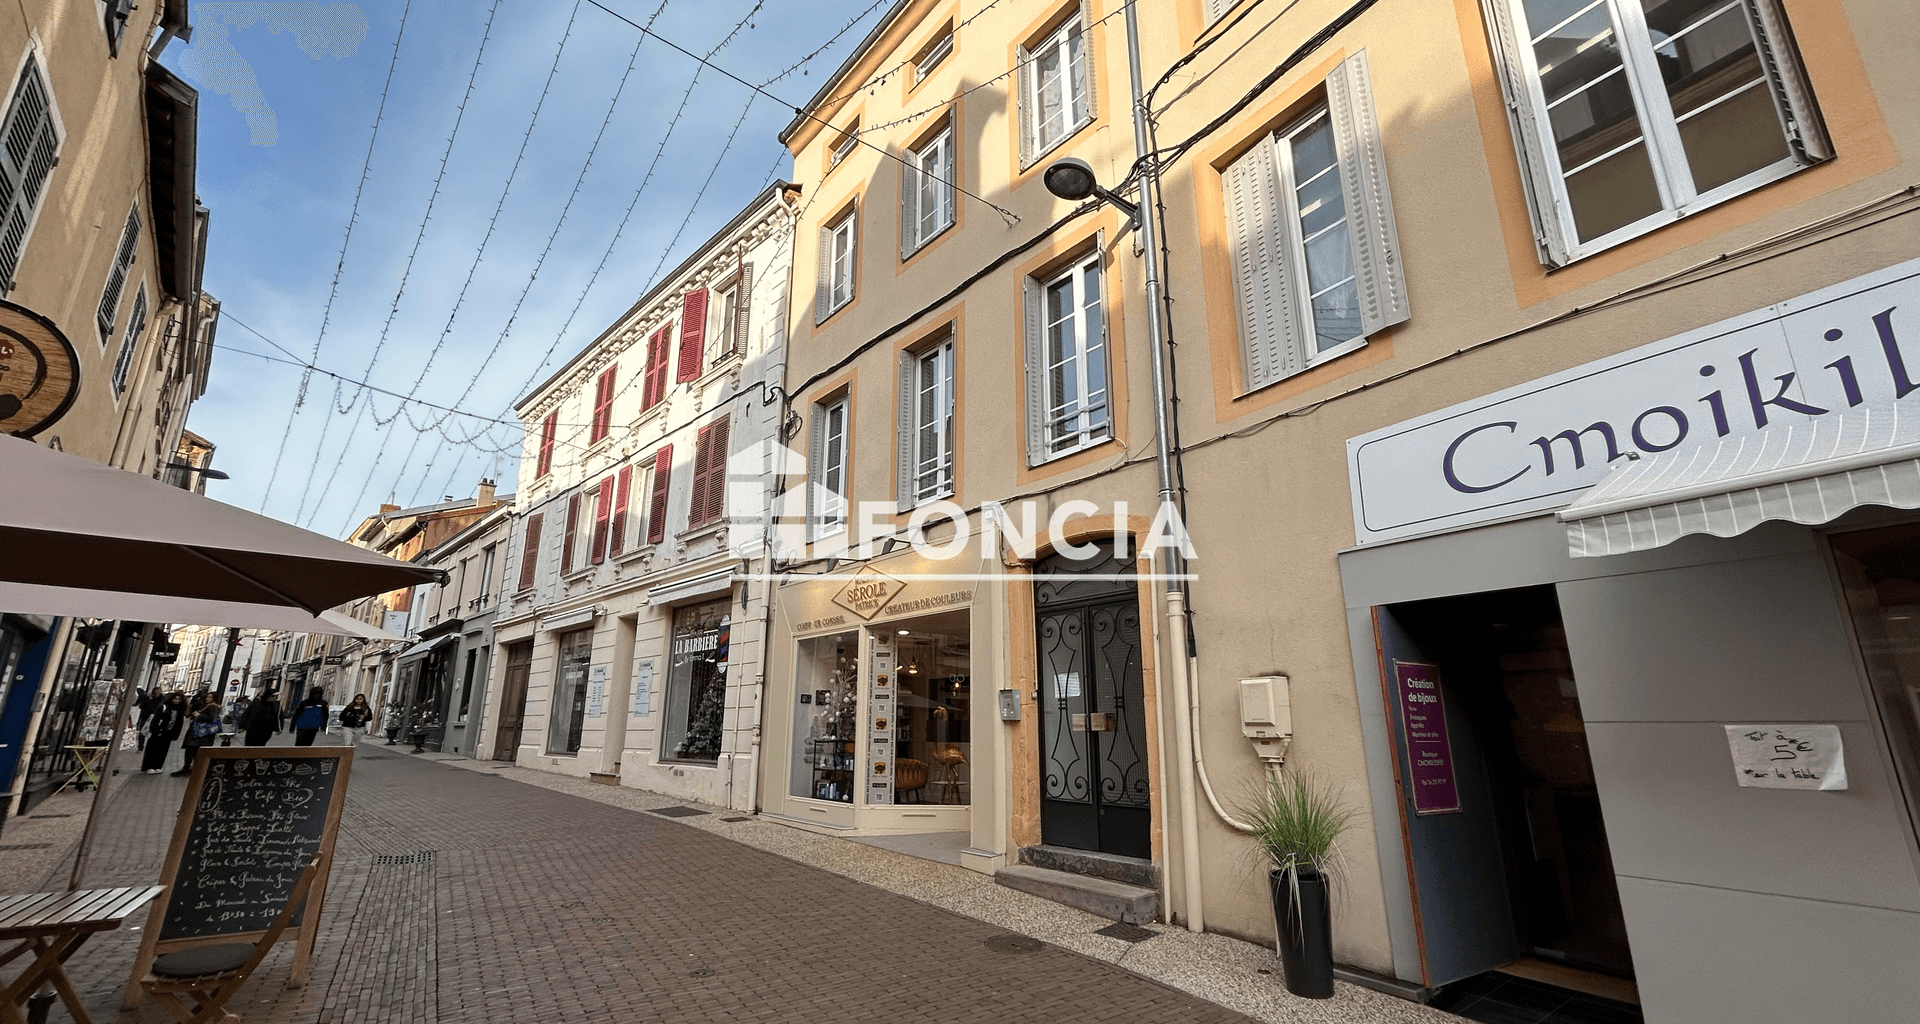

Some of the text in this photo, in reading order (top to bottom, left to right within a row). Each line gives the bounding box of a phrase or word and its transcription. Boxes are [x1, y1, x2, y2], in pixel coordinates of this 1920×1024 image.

[855, 598, 880, 611] PATRICK
[884, 590, 972, 614] CREATEUR DE COULEURS
[675, 633, 719, 655] LA BARBIÈRE
[1407, 678, 1435, 689] Création
[1408, 692, 1438, 705] de bijoux
[1775, 729, 1787, 741] à
[1775, 767, 1787, 778] la
[1790, 766, 1820, 779] table
[234, 780, 263, 789] Salon
[281, 777, 303, 788] Thé
[254, 790, 277, 803] Café
[207, 822, 227, 836] Café
